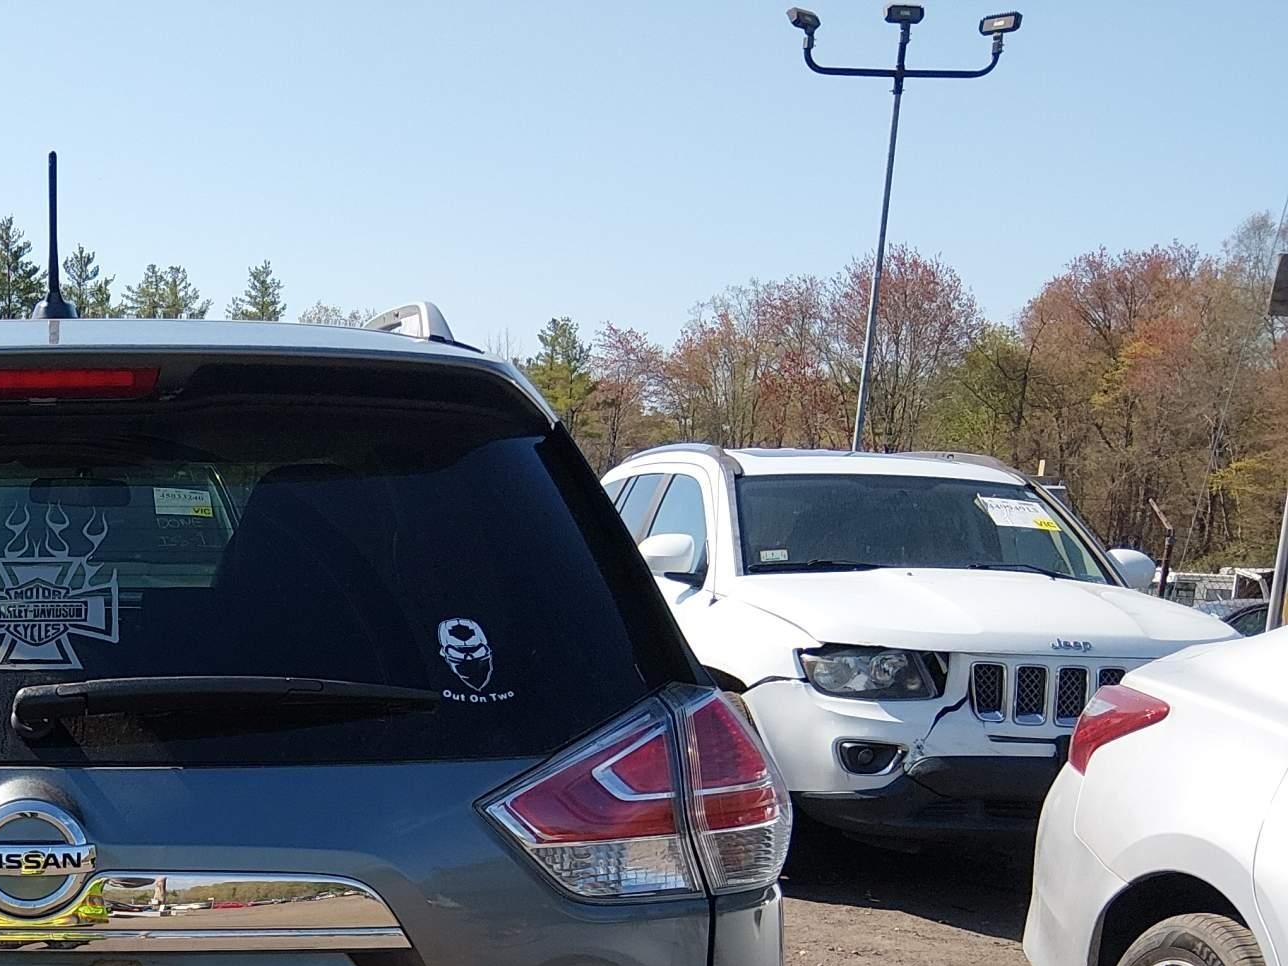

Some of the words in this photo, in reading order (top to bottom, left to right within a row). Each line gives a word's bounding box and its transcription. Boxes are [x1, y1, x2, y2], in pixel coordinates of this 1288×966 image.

[192, 507, 211, 516] VIC
[1033, 519, 1057, 528] VIC
[14, 585, 62, 600] MOTOR
[13, 623, 62, 642] CYCLES
[1051, 637, 1093, 653] Jeep
[443, 689, 466, 702] Out
[470, 694, 487, 703] On
[489, 690, 514, 702] Two
